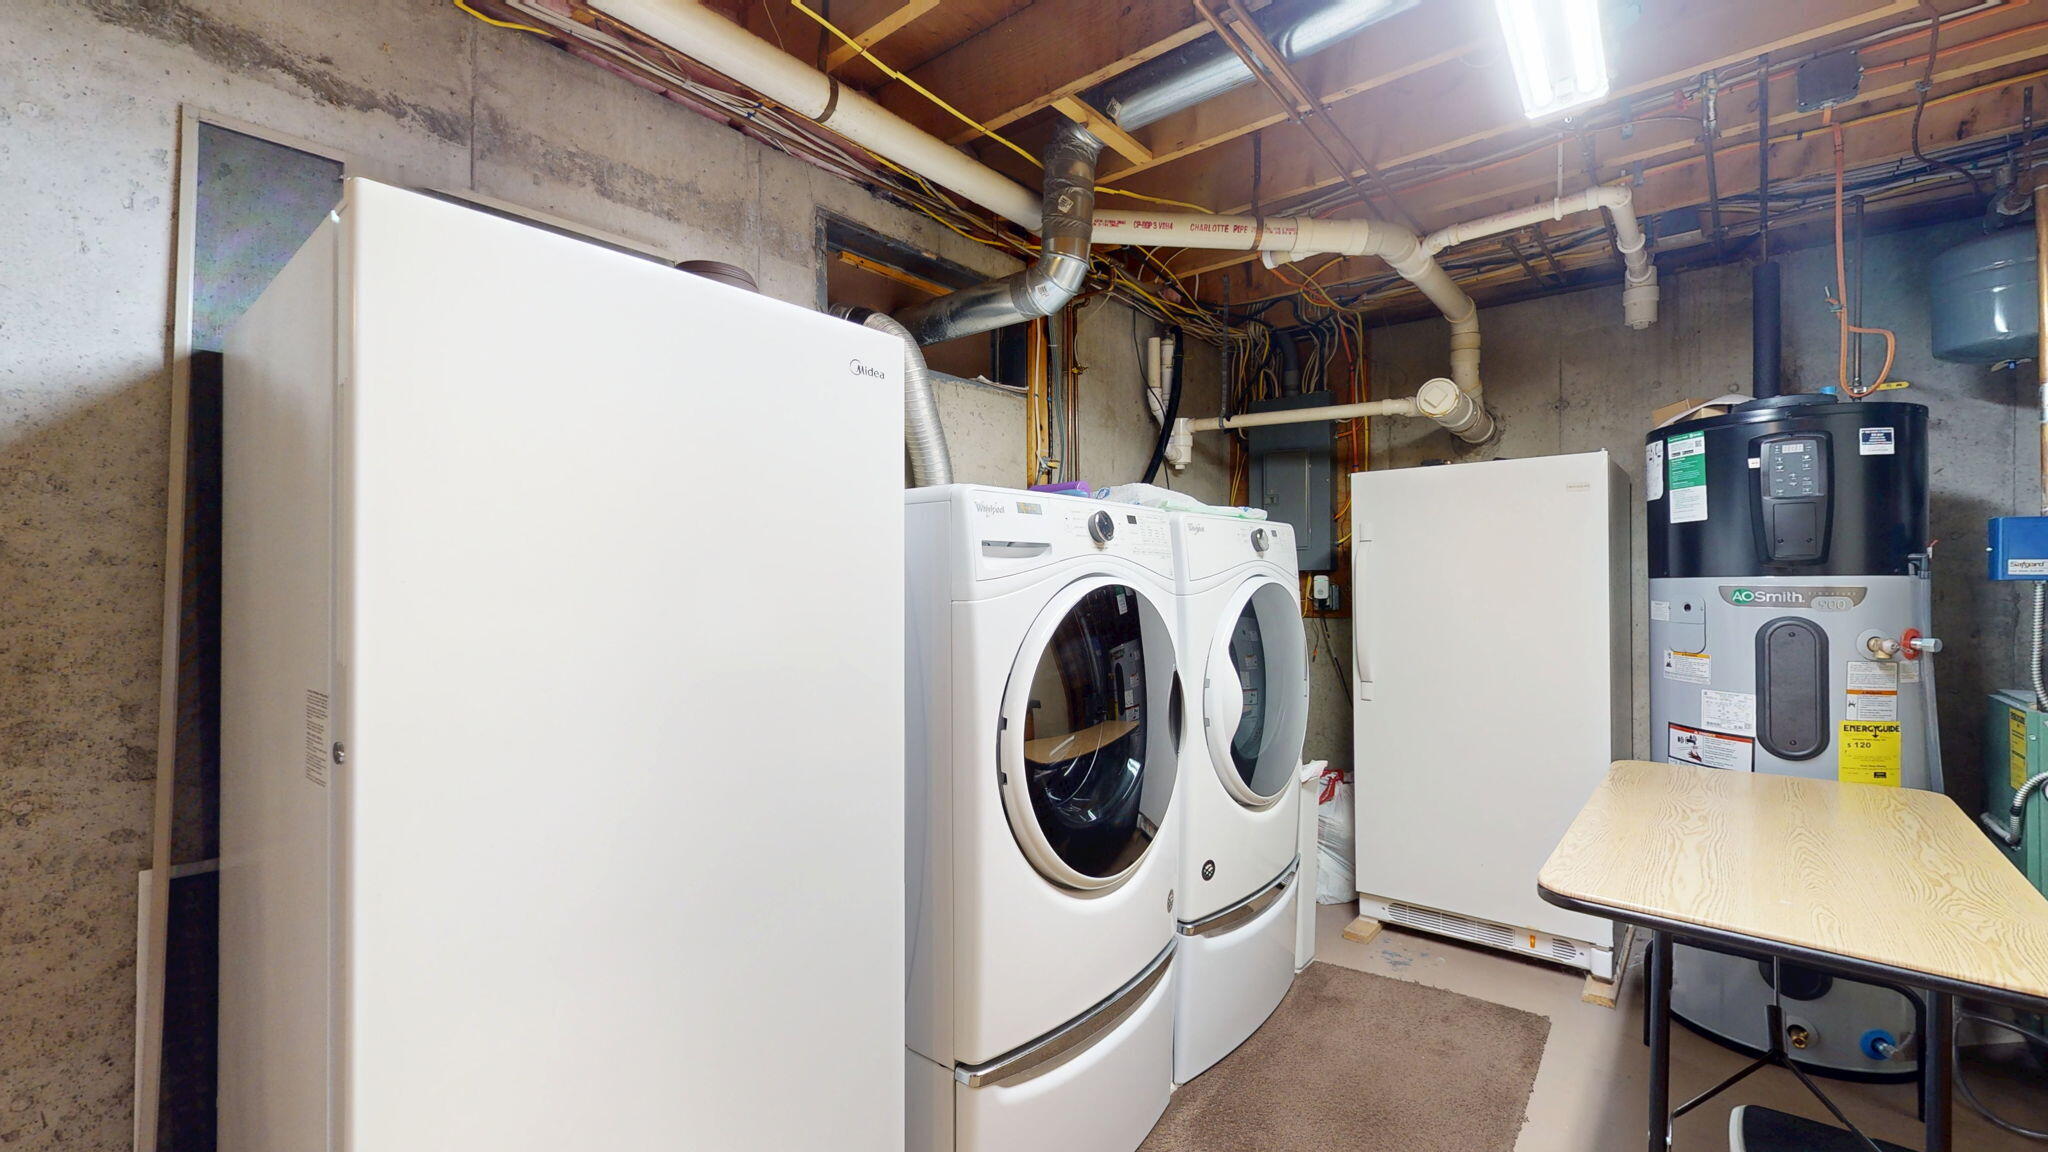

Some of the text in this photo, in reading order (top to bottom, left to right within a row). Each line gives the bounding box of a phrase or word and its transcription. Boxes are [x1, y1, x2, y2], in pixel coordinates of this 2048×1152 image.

[1190, 223, 1229, 233] CHARLOTTE
[1233, 225, 1248, 233] PIPE
[852, 361, 885, 380] Midea
